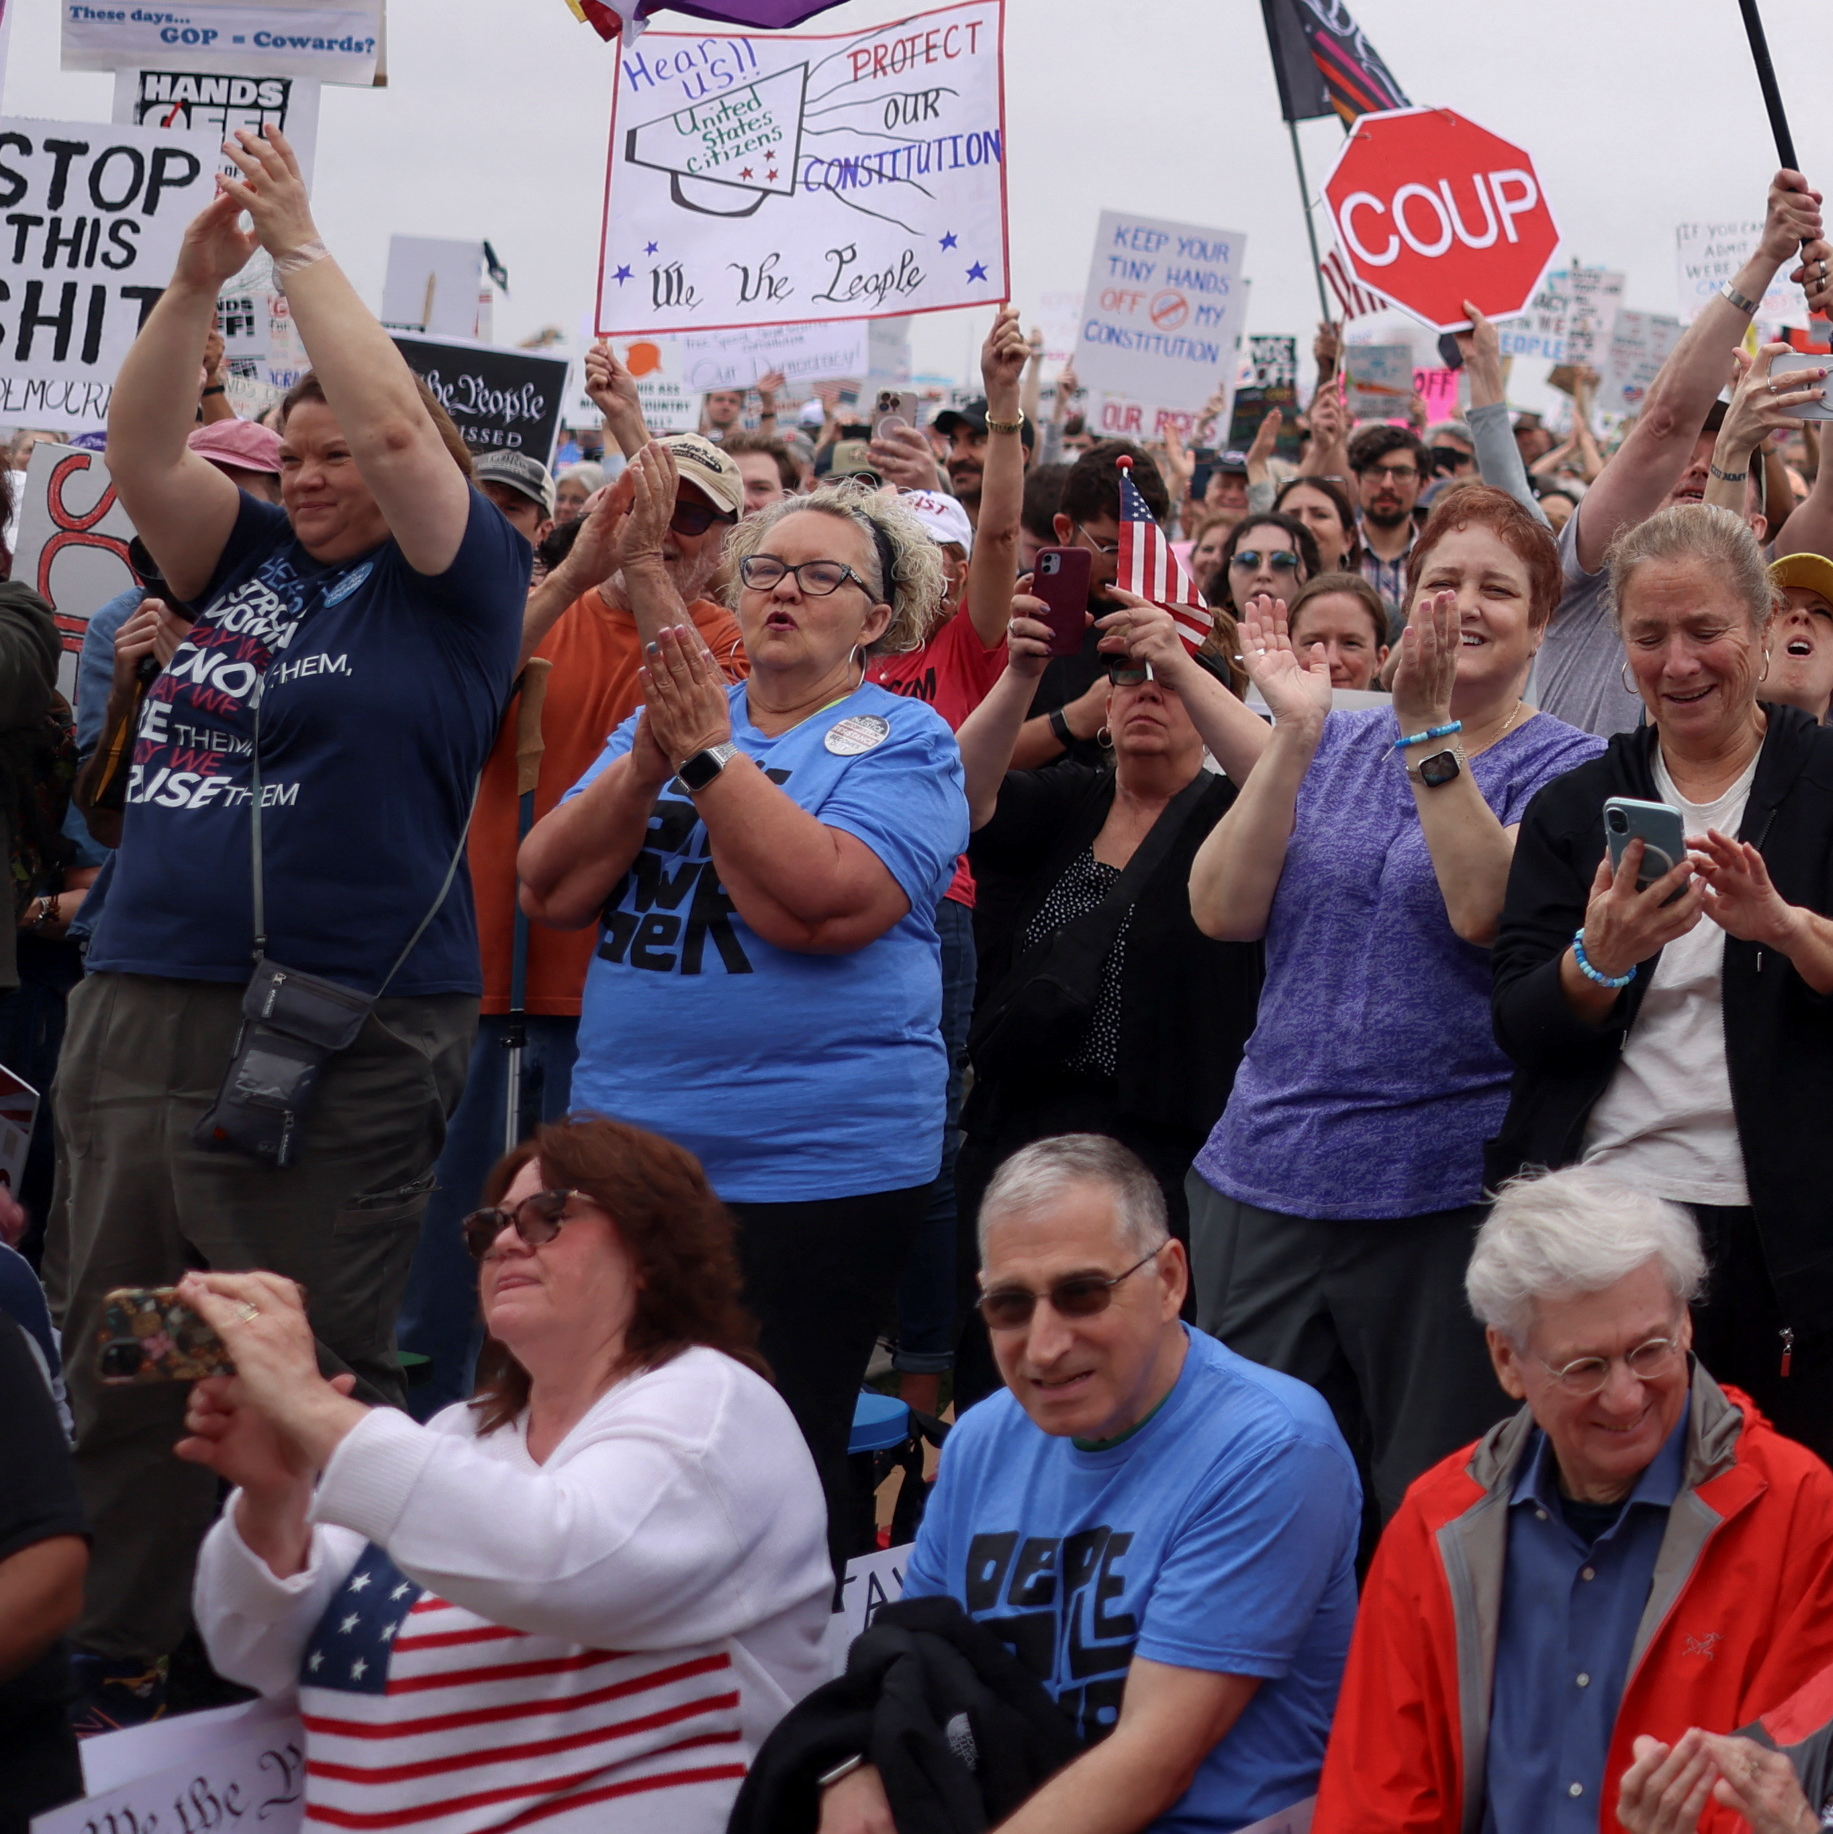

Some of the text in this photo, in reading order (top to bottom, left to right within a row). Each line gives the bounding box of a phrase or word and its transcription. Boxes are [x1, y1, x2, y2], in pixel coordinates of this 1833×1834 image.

[69, 5, 190, 24] These days...
[160, 28, 375, 53] GOP Cowards?
[848, 21, 984, 82] PROTECT
[622, 36, 718, 92] Hear
[143, 75, 284, 107] HANDS
[672, 86, 762, 136] United
[884, 88, 941, 130] OUR
[701, 111, 773, 150] States
[0, 132, 201, 216] STOP
[803, 129, 1001, 193] CONSTITUTION
[1339, 167, 1539, 267] COUP
[5, 213, 141, 270] THIS
[1114, 225, 1230, 264] KEEP YOUR
[1704, 242, 1748, 258] ADMIT
[650, 261, 703, 312] We
[812, 243, 926, 311] People
[1107, 254, 1231, 296] TINY HANDS
[1685, 263, 1731, 279] WERE
[1100, 286, 1227, 327] OFF MY
[1084, 319, 1220, 365] CONSTITUTION
[448, 374, 547, 426] People
[1413, 371, 1455, 400] OFF
[1101, 404, 1143, 433] OUR
[190, 685, 243, 720] WE
[169, 746, 225, 776] WE
